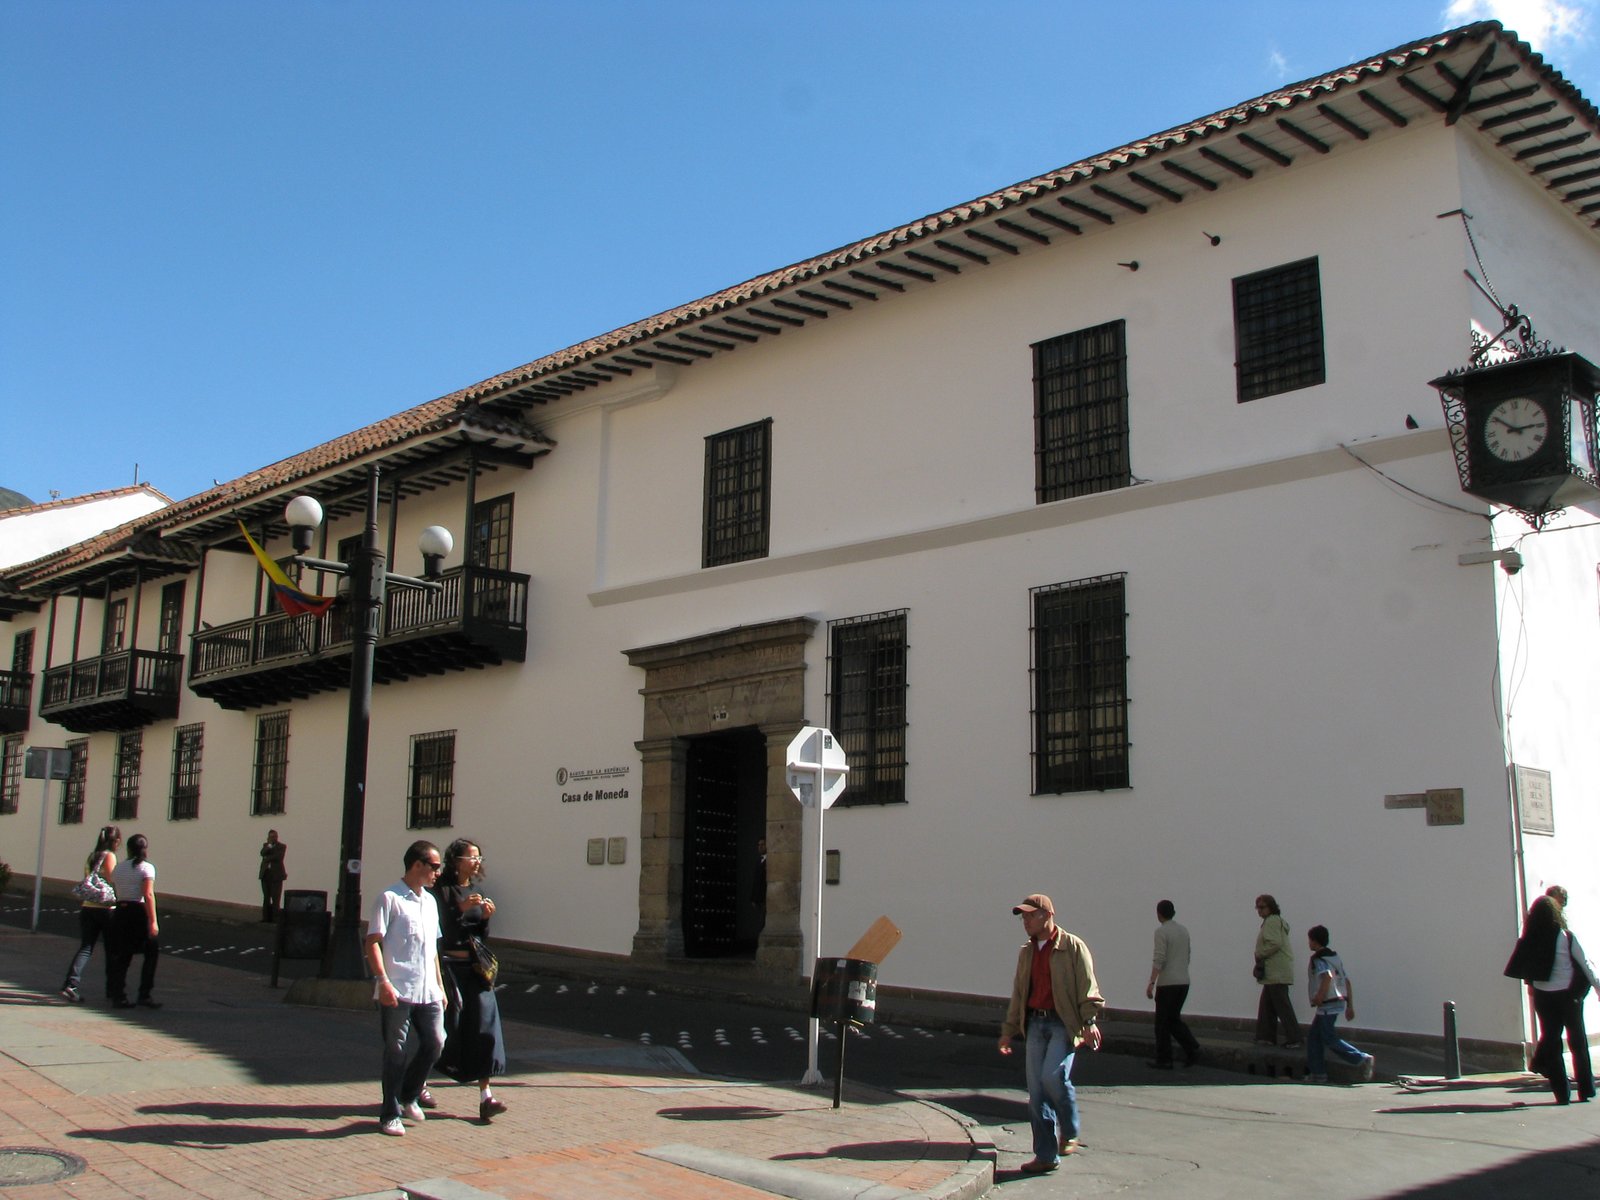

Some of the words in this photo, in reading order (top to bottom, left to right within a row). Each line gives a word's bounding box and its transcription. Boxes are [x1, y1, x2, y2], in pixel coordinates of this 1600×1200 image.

[561, 793, 581, 802] Casa
[583, 791, 593, 802] de
[595, 788, 629, 801] Moneda
